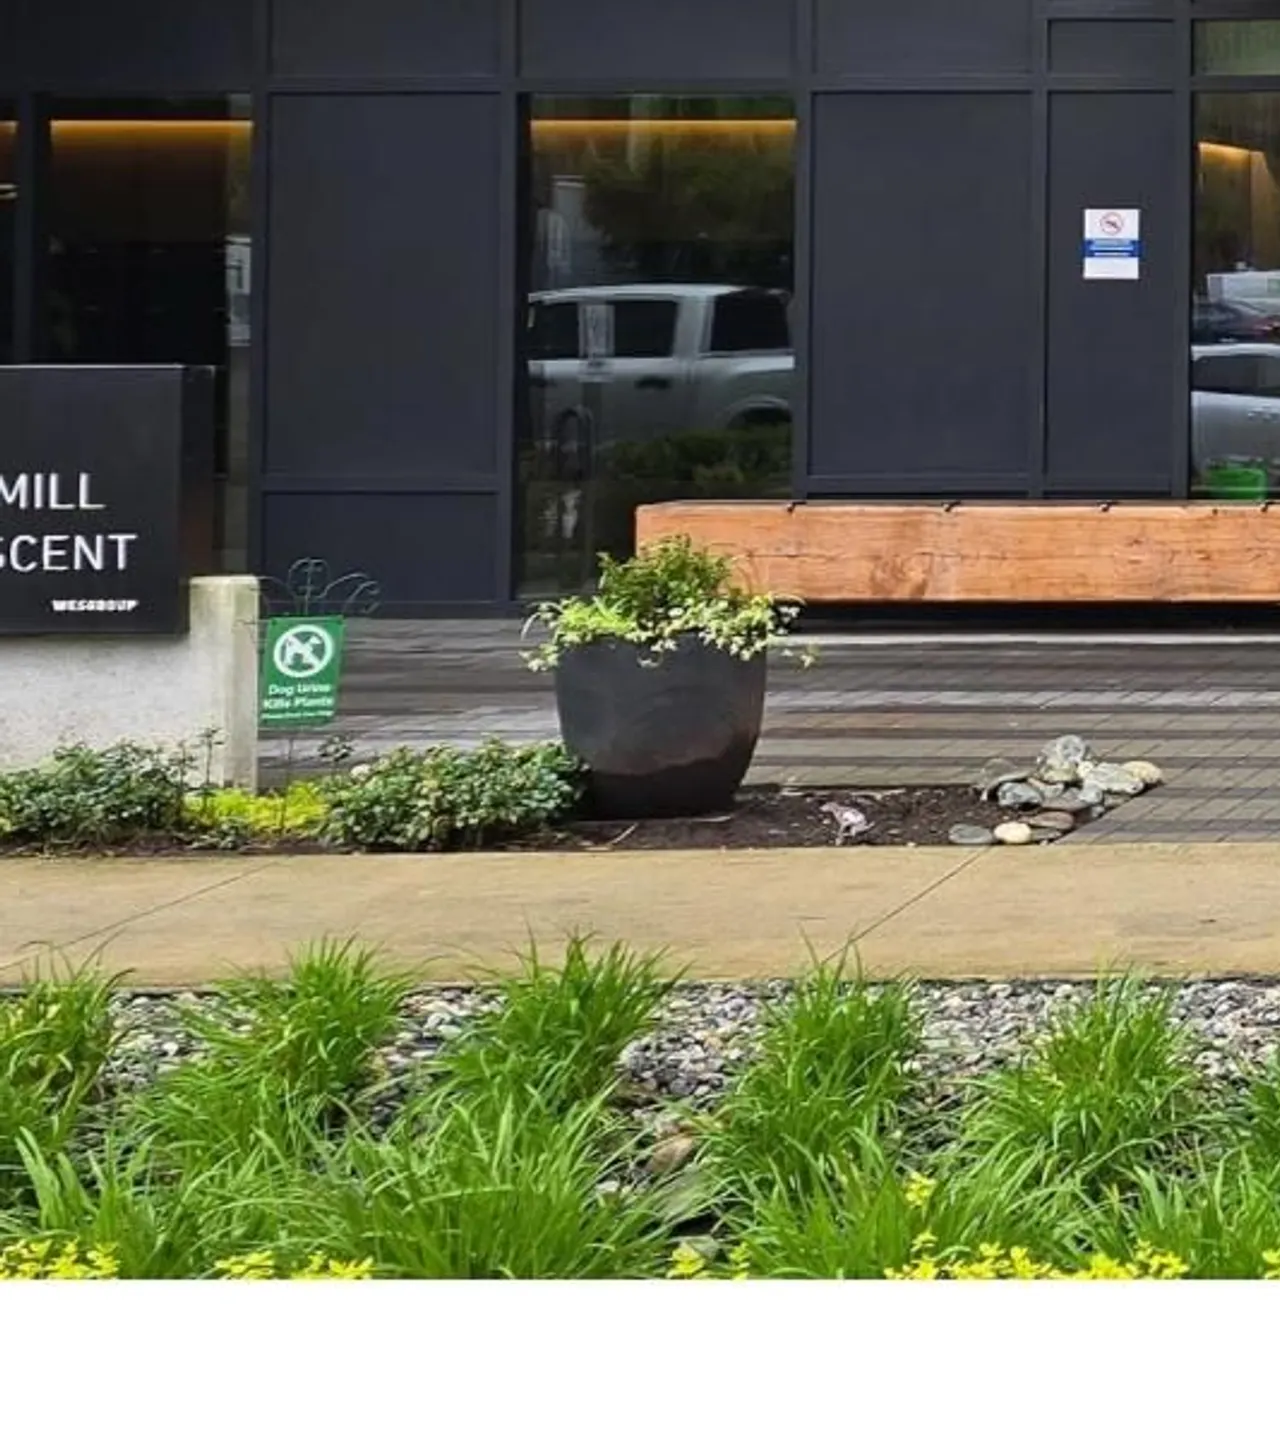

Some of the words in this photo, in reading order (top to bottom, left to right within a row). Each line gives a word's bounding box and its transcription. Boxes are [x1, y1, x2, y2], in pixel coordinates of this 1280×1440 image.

[0, 472, 106, 510] MILL
[0, 534, 138, 572] CENT
[268, 684, 294, 697] Dog
